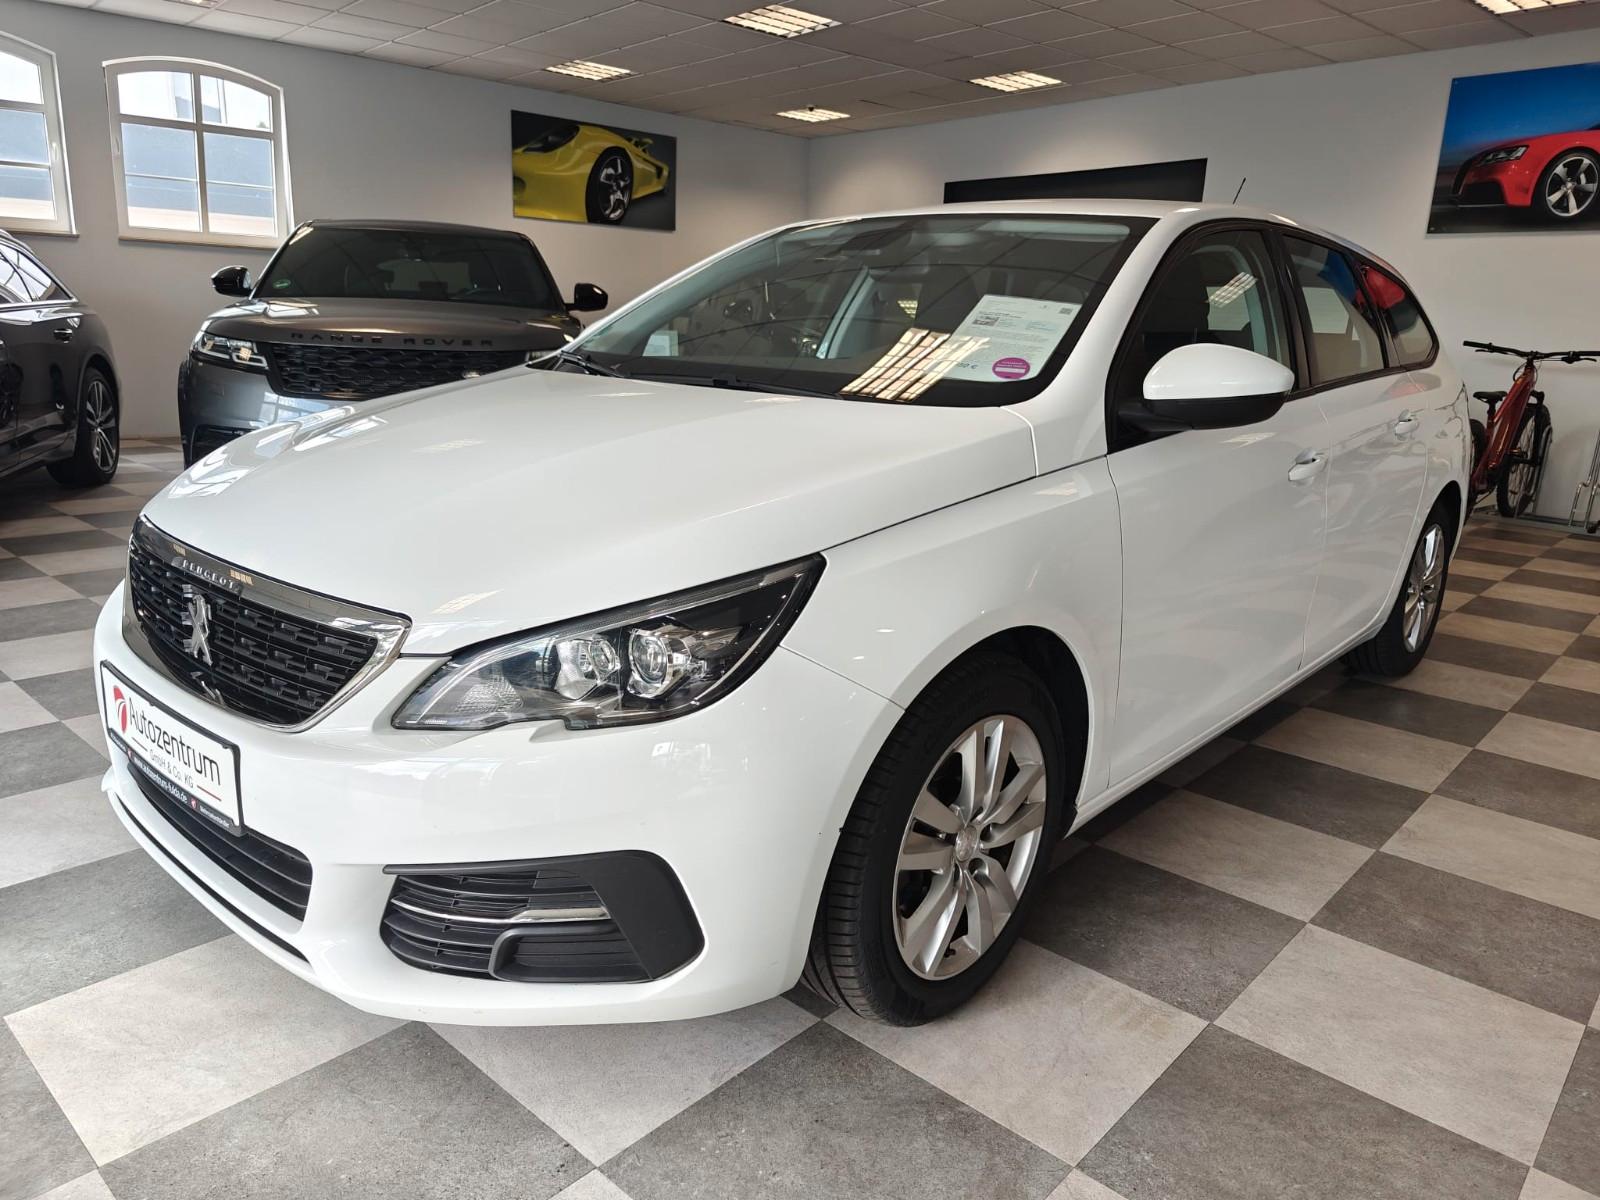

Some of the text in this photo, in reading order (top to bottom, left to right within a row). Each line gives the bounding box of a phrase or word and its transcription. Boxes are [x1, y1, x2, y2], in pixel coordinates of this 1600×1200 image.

[291, 332, 494, 347] RANGE ROVER
[182, 559, 235, 589] PEUGEOT
[129, 697, 221, 786] Autozentrum
[185, 773, 194, 788] KG
